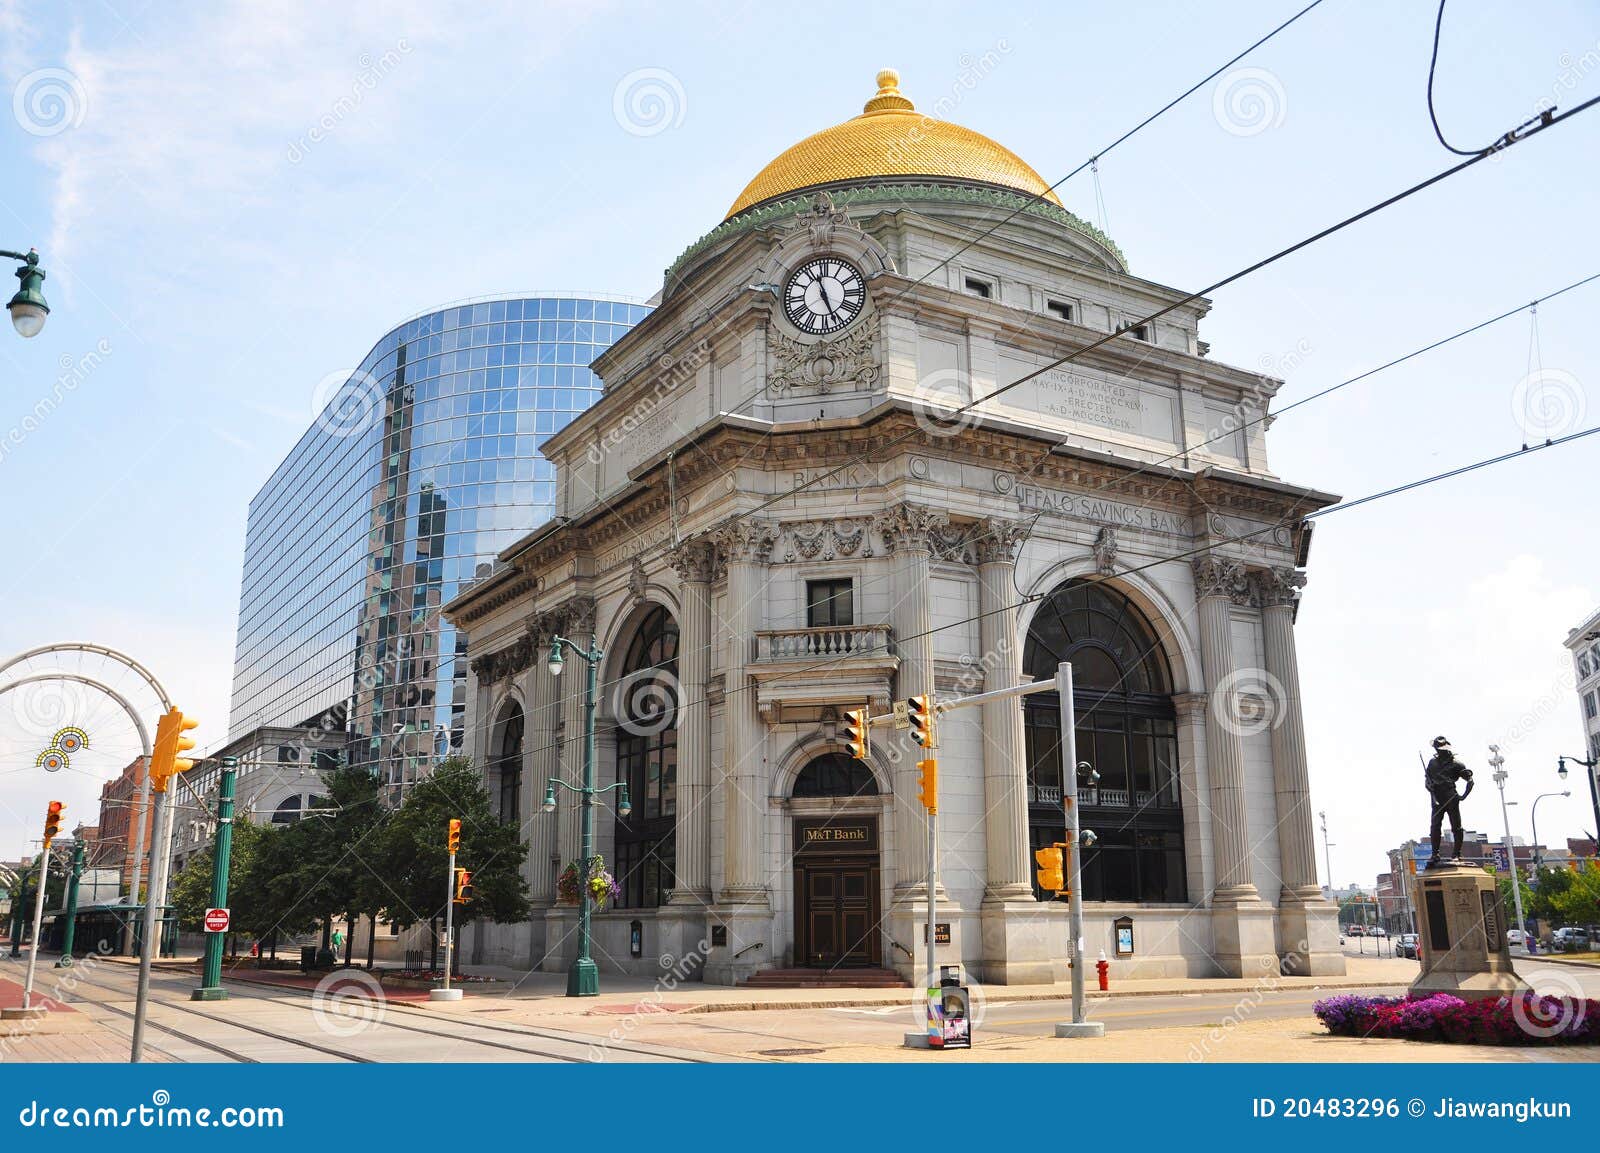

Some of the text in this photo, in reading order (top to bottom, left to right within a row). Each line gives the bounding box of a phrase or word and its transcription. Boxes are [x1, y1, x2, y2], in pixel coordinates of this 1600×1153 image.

[793, 466, 861, 489] BANK
[1081, 498, 1143, 526] SAVINGS
[1150, 514, 1188, 532] BANK
[807, 829, 865, 840] M&T Bank
